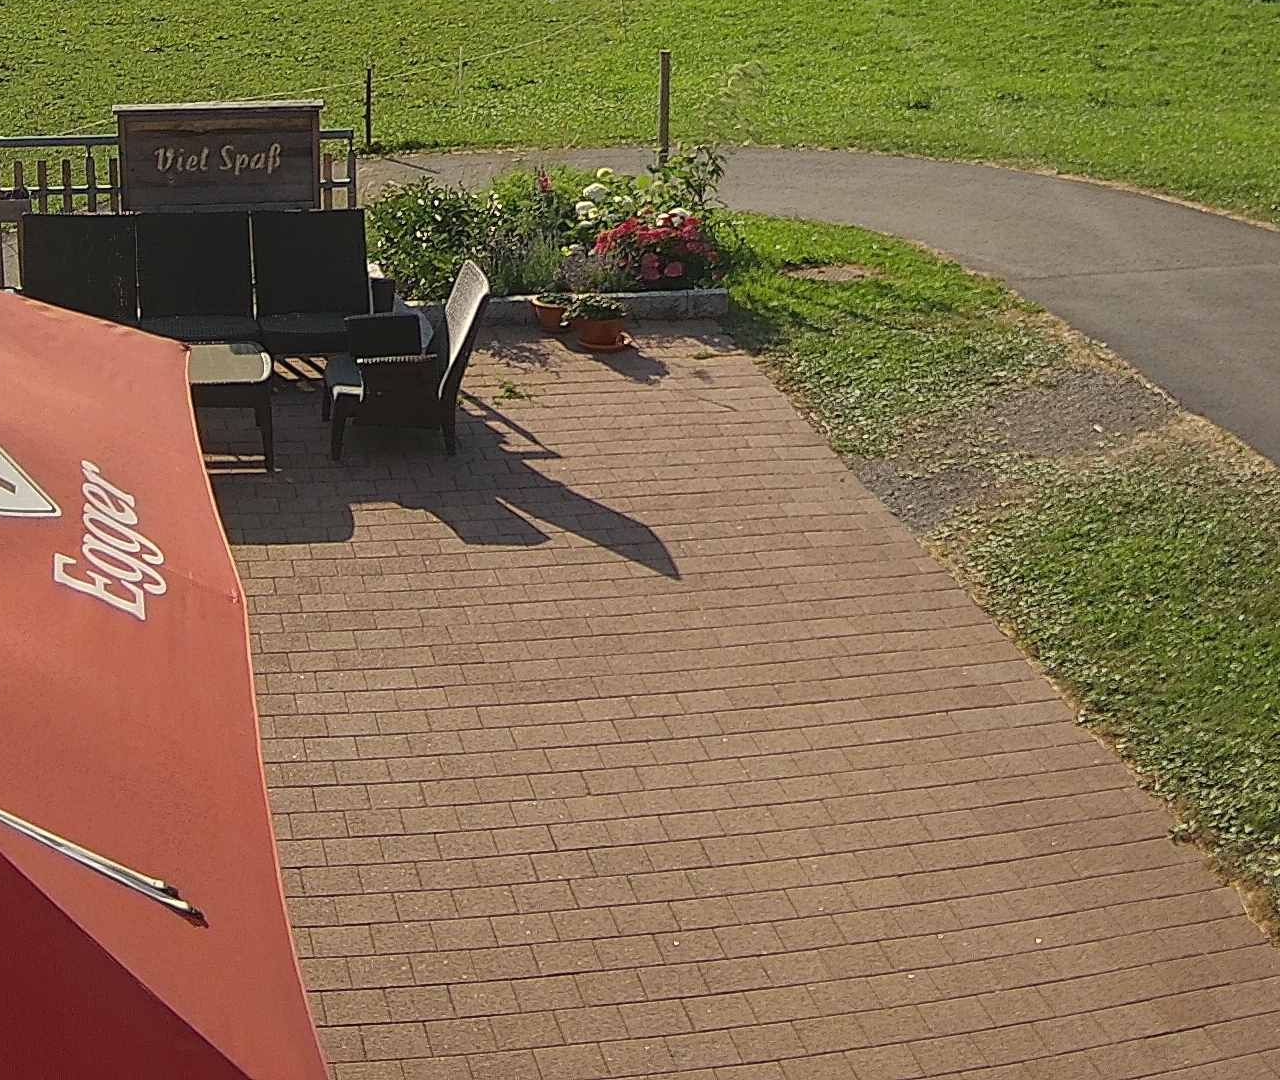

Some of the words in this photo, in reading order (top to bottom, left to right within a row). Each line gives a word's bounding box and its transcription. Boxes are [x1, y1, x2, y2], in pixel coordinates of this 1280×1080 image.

[154, 147, 209, 172] Viel
[219, 142, 282, 176] Spaß
[54, 459, 167, 621] Egger
